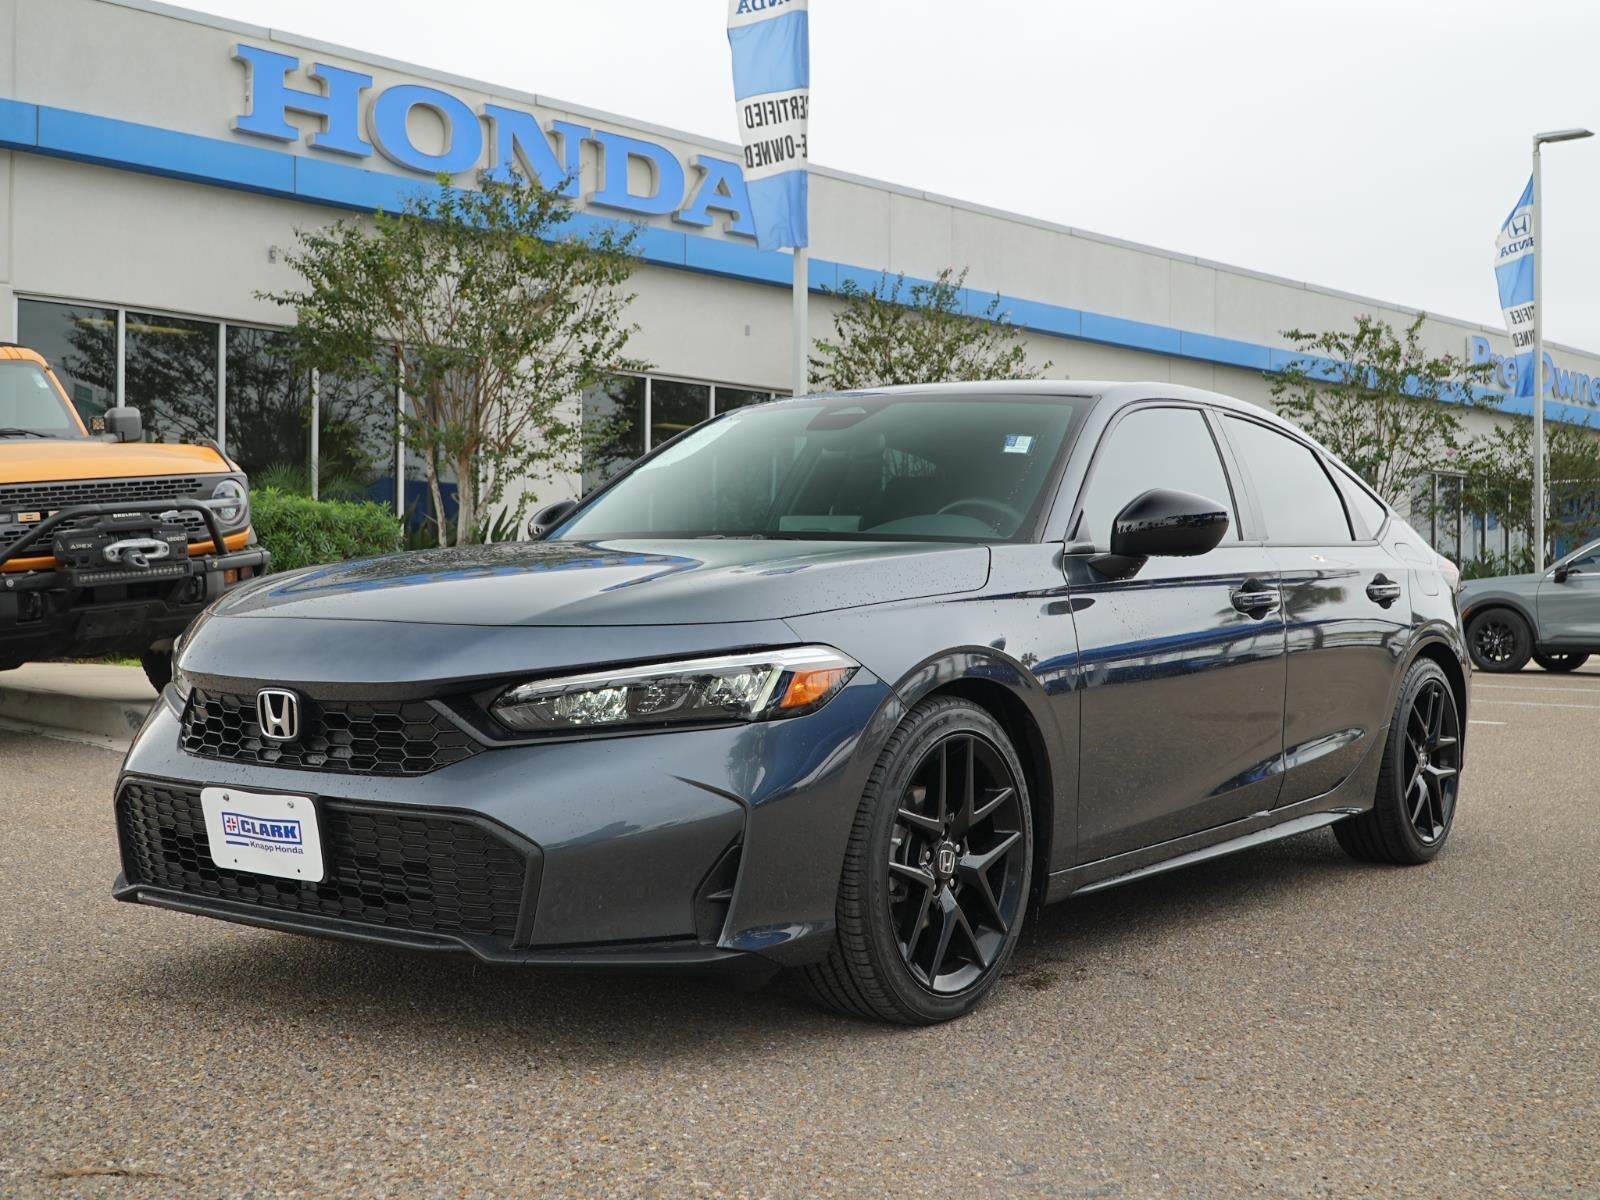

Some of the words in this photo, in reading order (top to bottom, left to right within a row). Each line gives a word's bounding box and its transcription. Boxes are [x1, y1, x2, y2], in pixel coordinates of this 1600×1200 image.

[231, 43, 757, 238] HONDA
[240, 819, 298, 839] CLARK
[249, 840, 275, 852] Knapp
[275, 844, 304, 855] Honda
